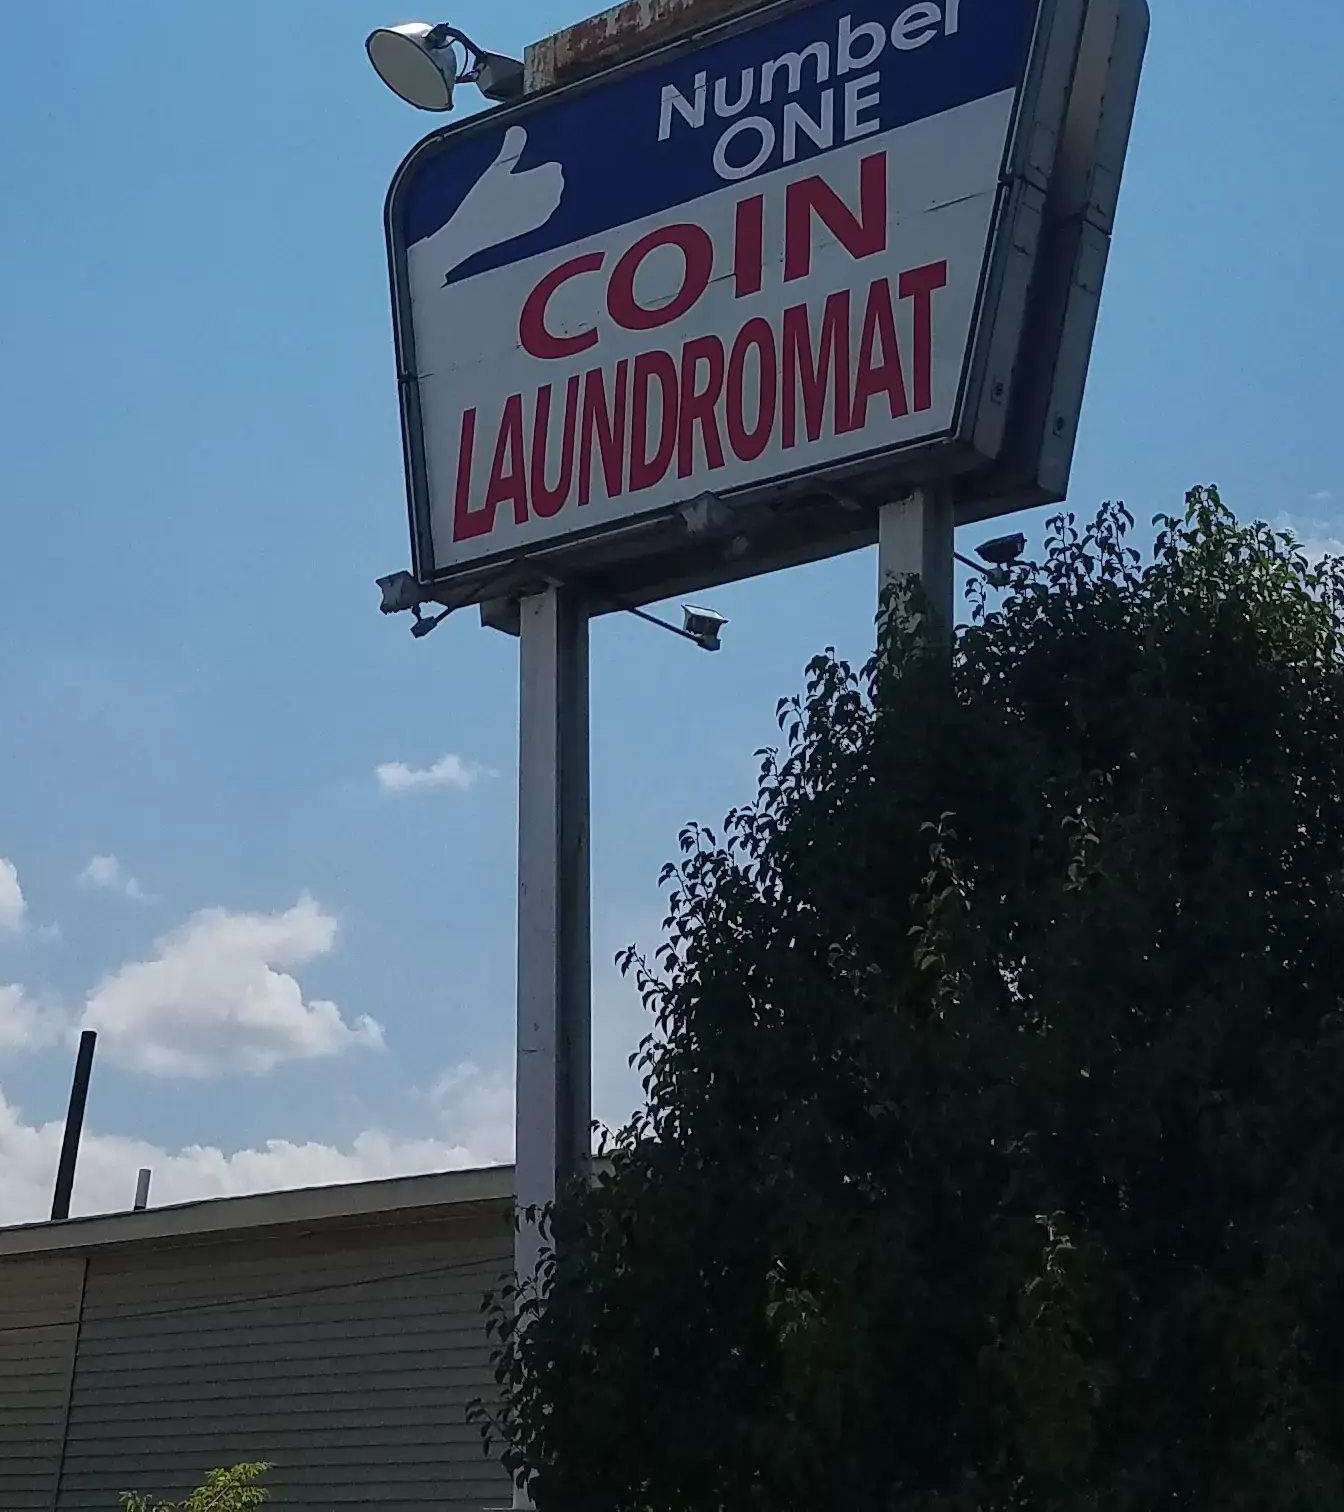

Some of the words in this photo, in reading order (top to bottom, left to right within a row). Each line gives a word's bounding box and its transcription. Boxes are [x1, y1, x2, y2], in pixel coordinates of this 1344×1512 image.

[712, 71, 882, 181] ONE
[518, 150, 887, 360] COIN
[452, 259, 947, 543] LAUNDROMAT
